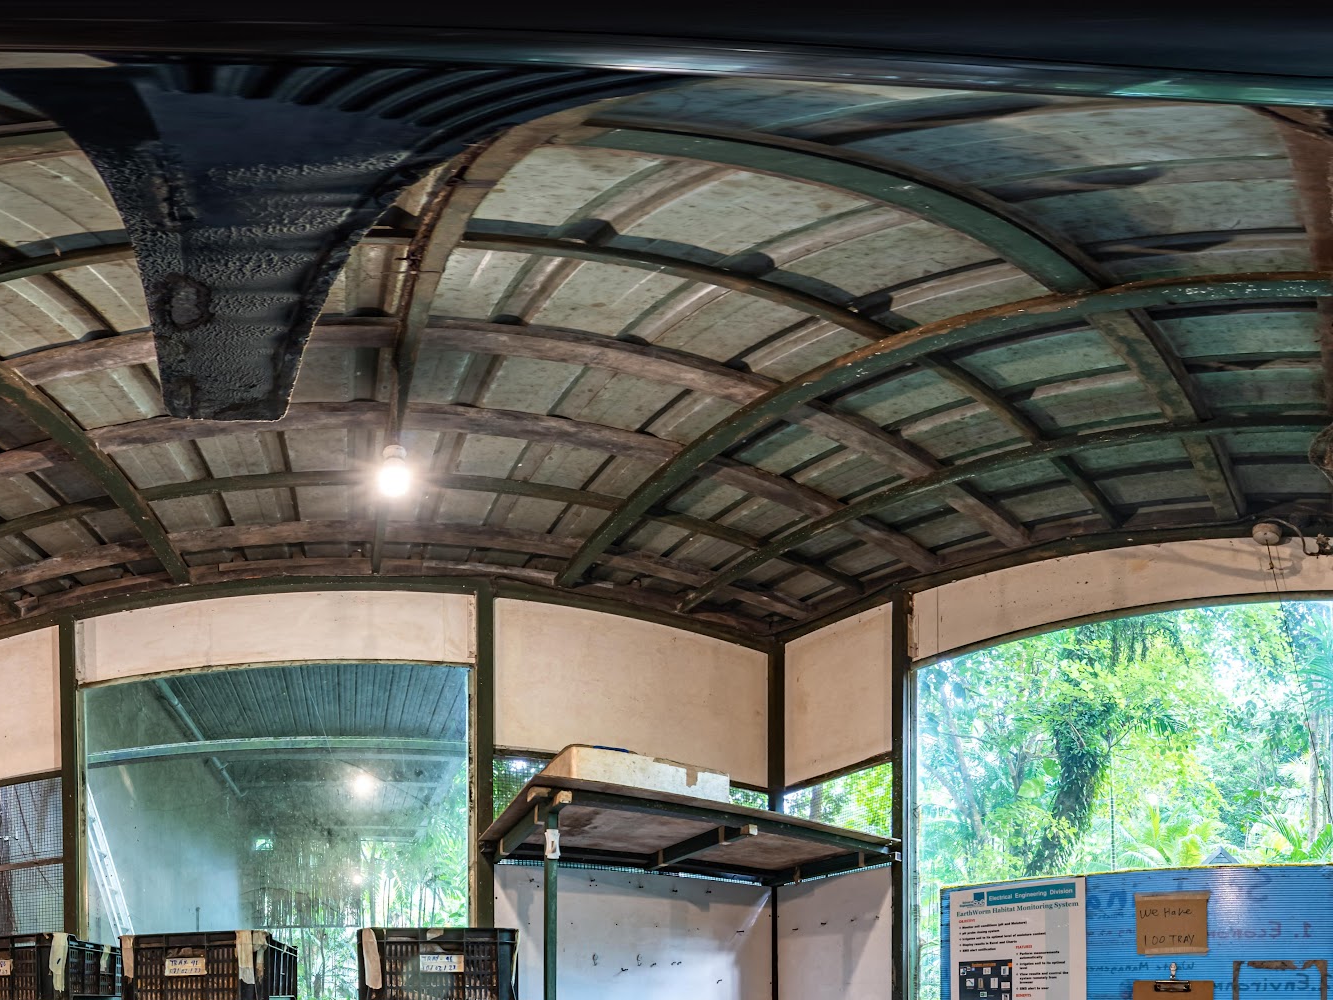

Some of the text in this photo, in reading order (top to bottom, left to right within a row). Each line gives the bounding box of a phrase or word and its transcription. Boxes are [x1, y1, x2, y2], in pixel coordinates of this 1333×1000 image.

[1015, 890, 1047, 900] Engineering
[956, 909, 991, 917] EarthWorm
[1017, 904, 1053, 912] Monitoring
[1054, 902, 1079, 910] System
[1140, 908, 1159, 919] We
[1169, 934, 1194, 946] TRAY
